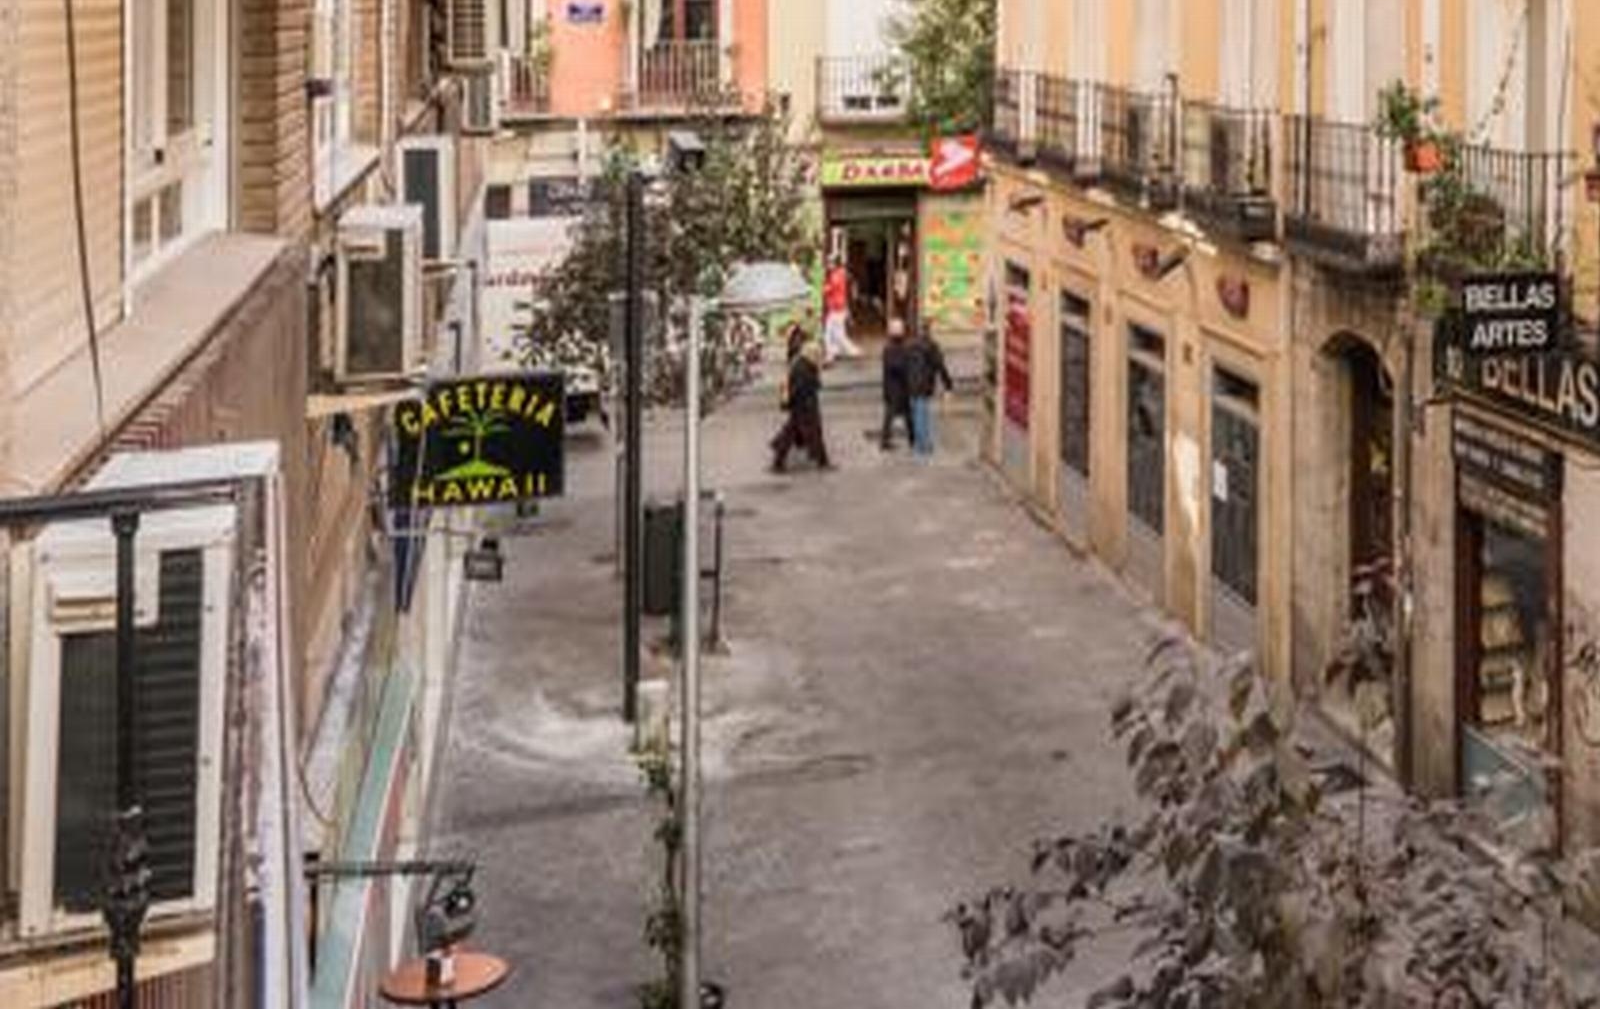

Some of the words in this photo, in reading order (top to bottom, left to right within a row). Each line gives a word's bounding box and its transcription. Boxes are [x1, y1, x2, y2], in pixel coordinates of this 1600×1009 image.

[1464, 282, 1555, 313] BELLAS
[1470, 318, 1548, 348] ARTES
[1481, 352, 1600, 427] BELLAS
[402, 381, 555, 434] CAFETERIA
[413, 473, 547, 502] HAWAII
